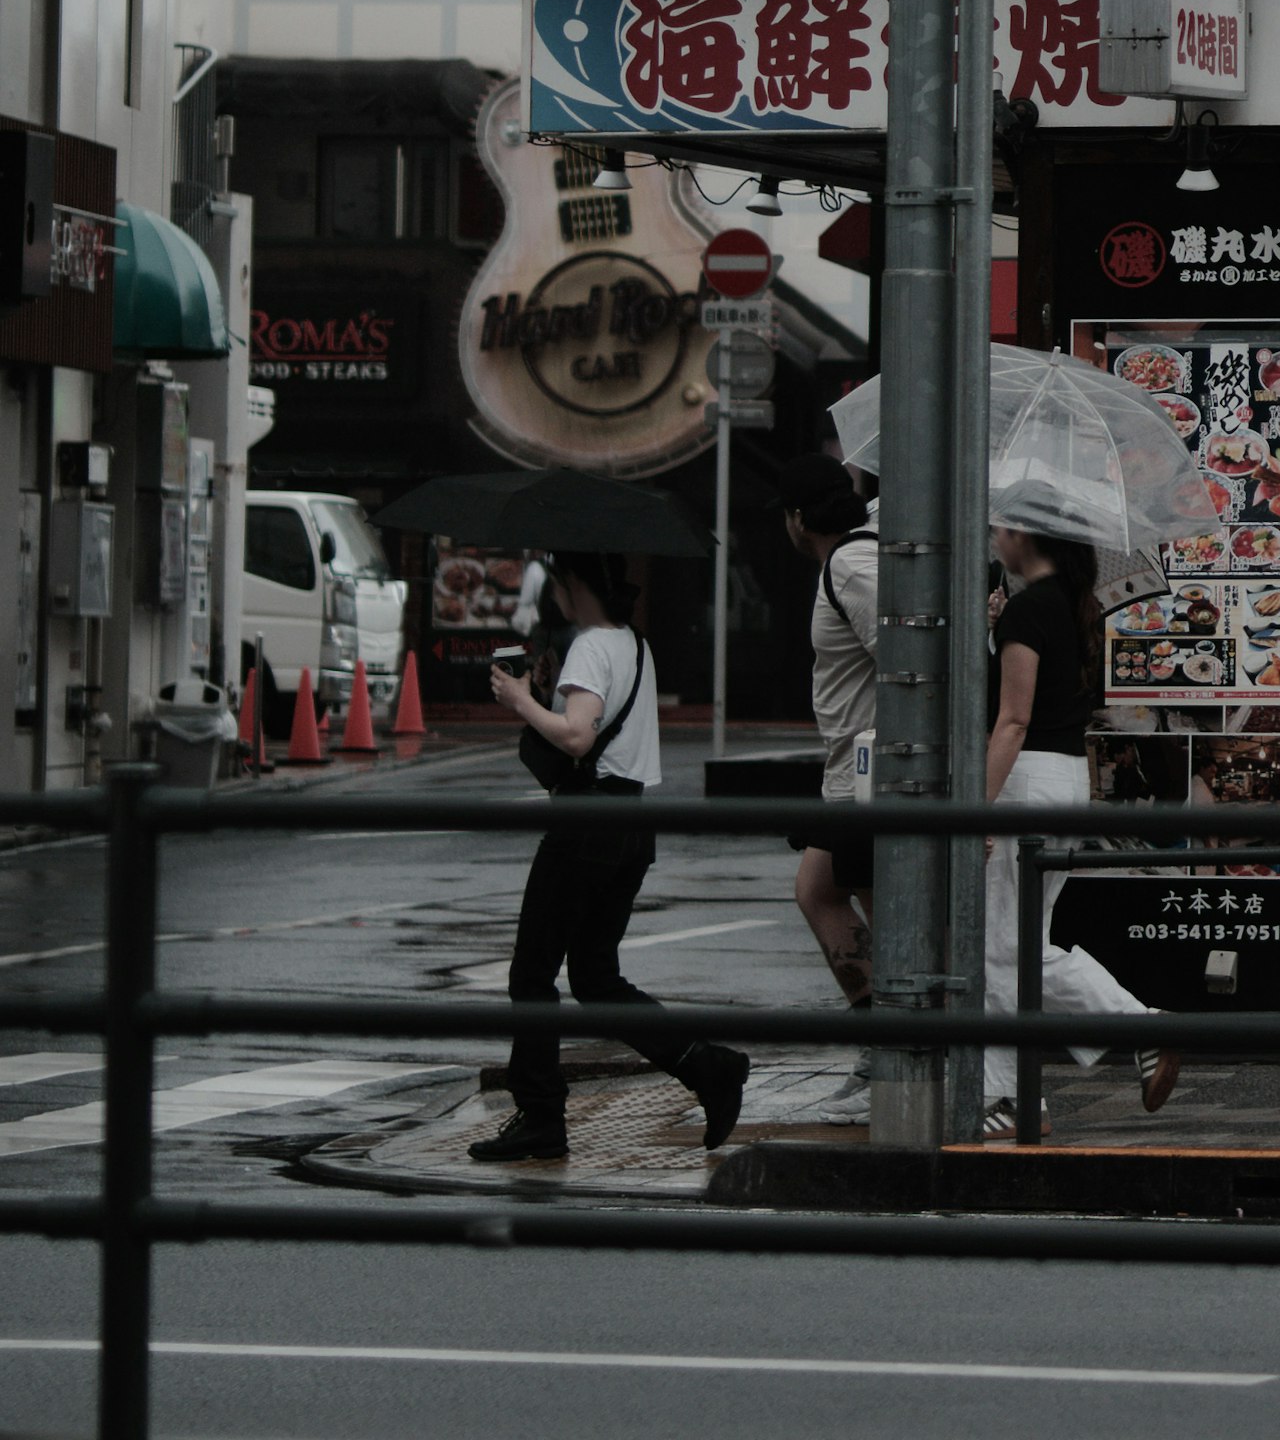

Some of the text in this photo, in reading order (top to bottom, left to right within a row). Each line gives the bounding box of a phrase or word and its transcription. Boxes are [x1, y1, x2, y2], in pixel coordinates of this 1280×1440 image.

[1177, 8, 1238, 78] 24時間
[705, 308, 767, 323] 自転車を除く
[306, 362, 387, 380] STEAKS
[1205, 350, 1251, 434] 磯めし
[1160, 888, 1265, 915] 六本木店
[1145, 923, 1280, 940] 03-5413-7951
